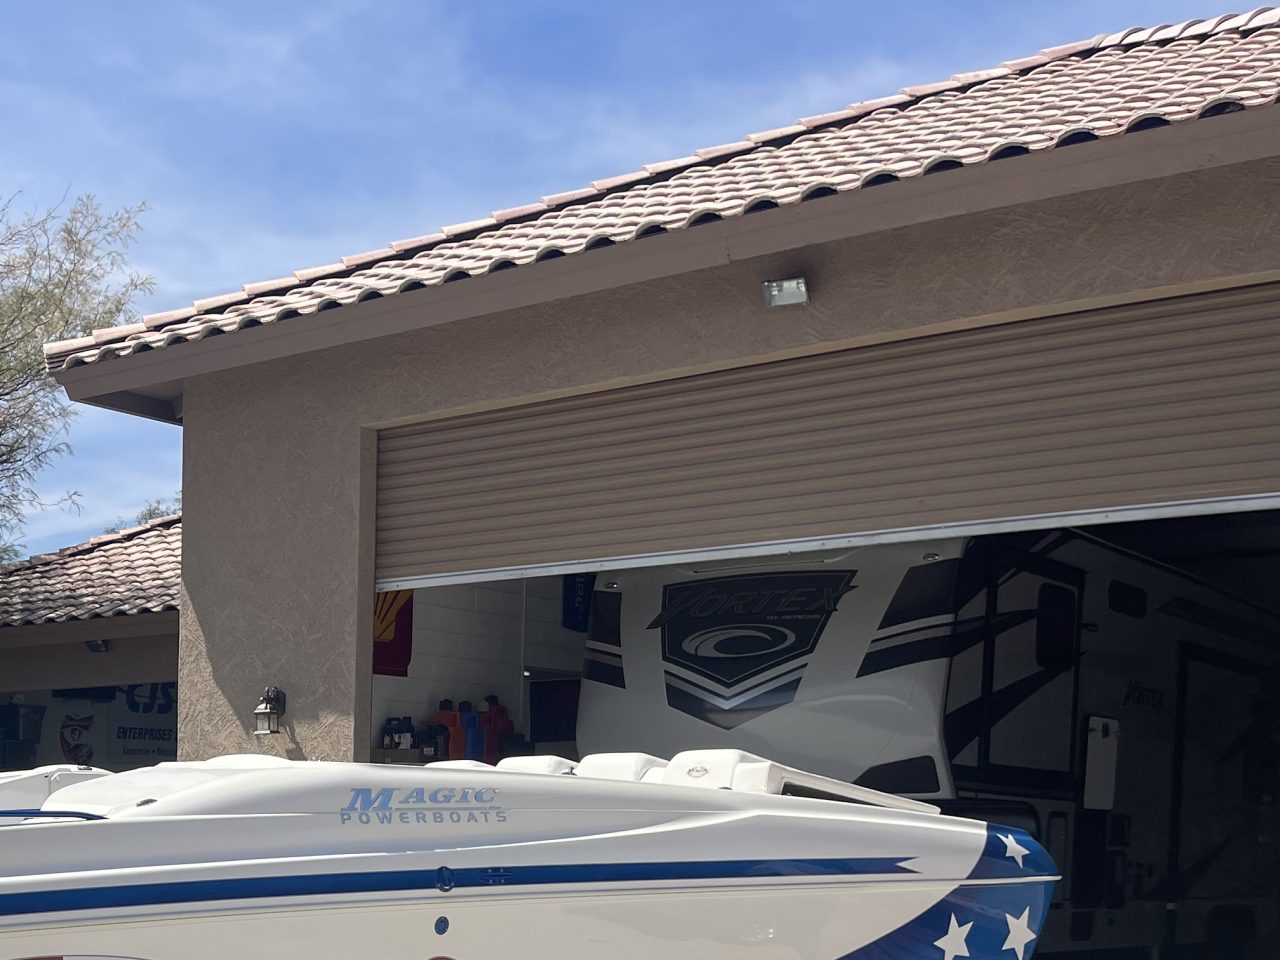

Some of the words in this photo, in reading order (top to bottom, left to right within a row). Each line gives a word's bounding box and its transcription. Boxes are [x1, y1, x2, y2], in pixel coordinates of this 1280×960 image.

[646, 585, 858, 629] VORTEX
[117, 726, 173, 741] ENTERPRISES
[340, 787, 502, 812] MAGIC
[339, 810, 508, 825] POWERBOATS
